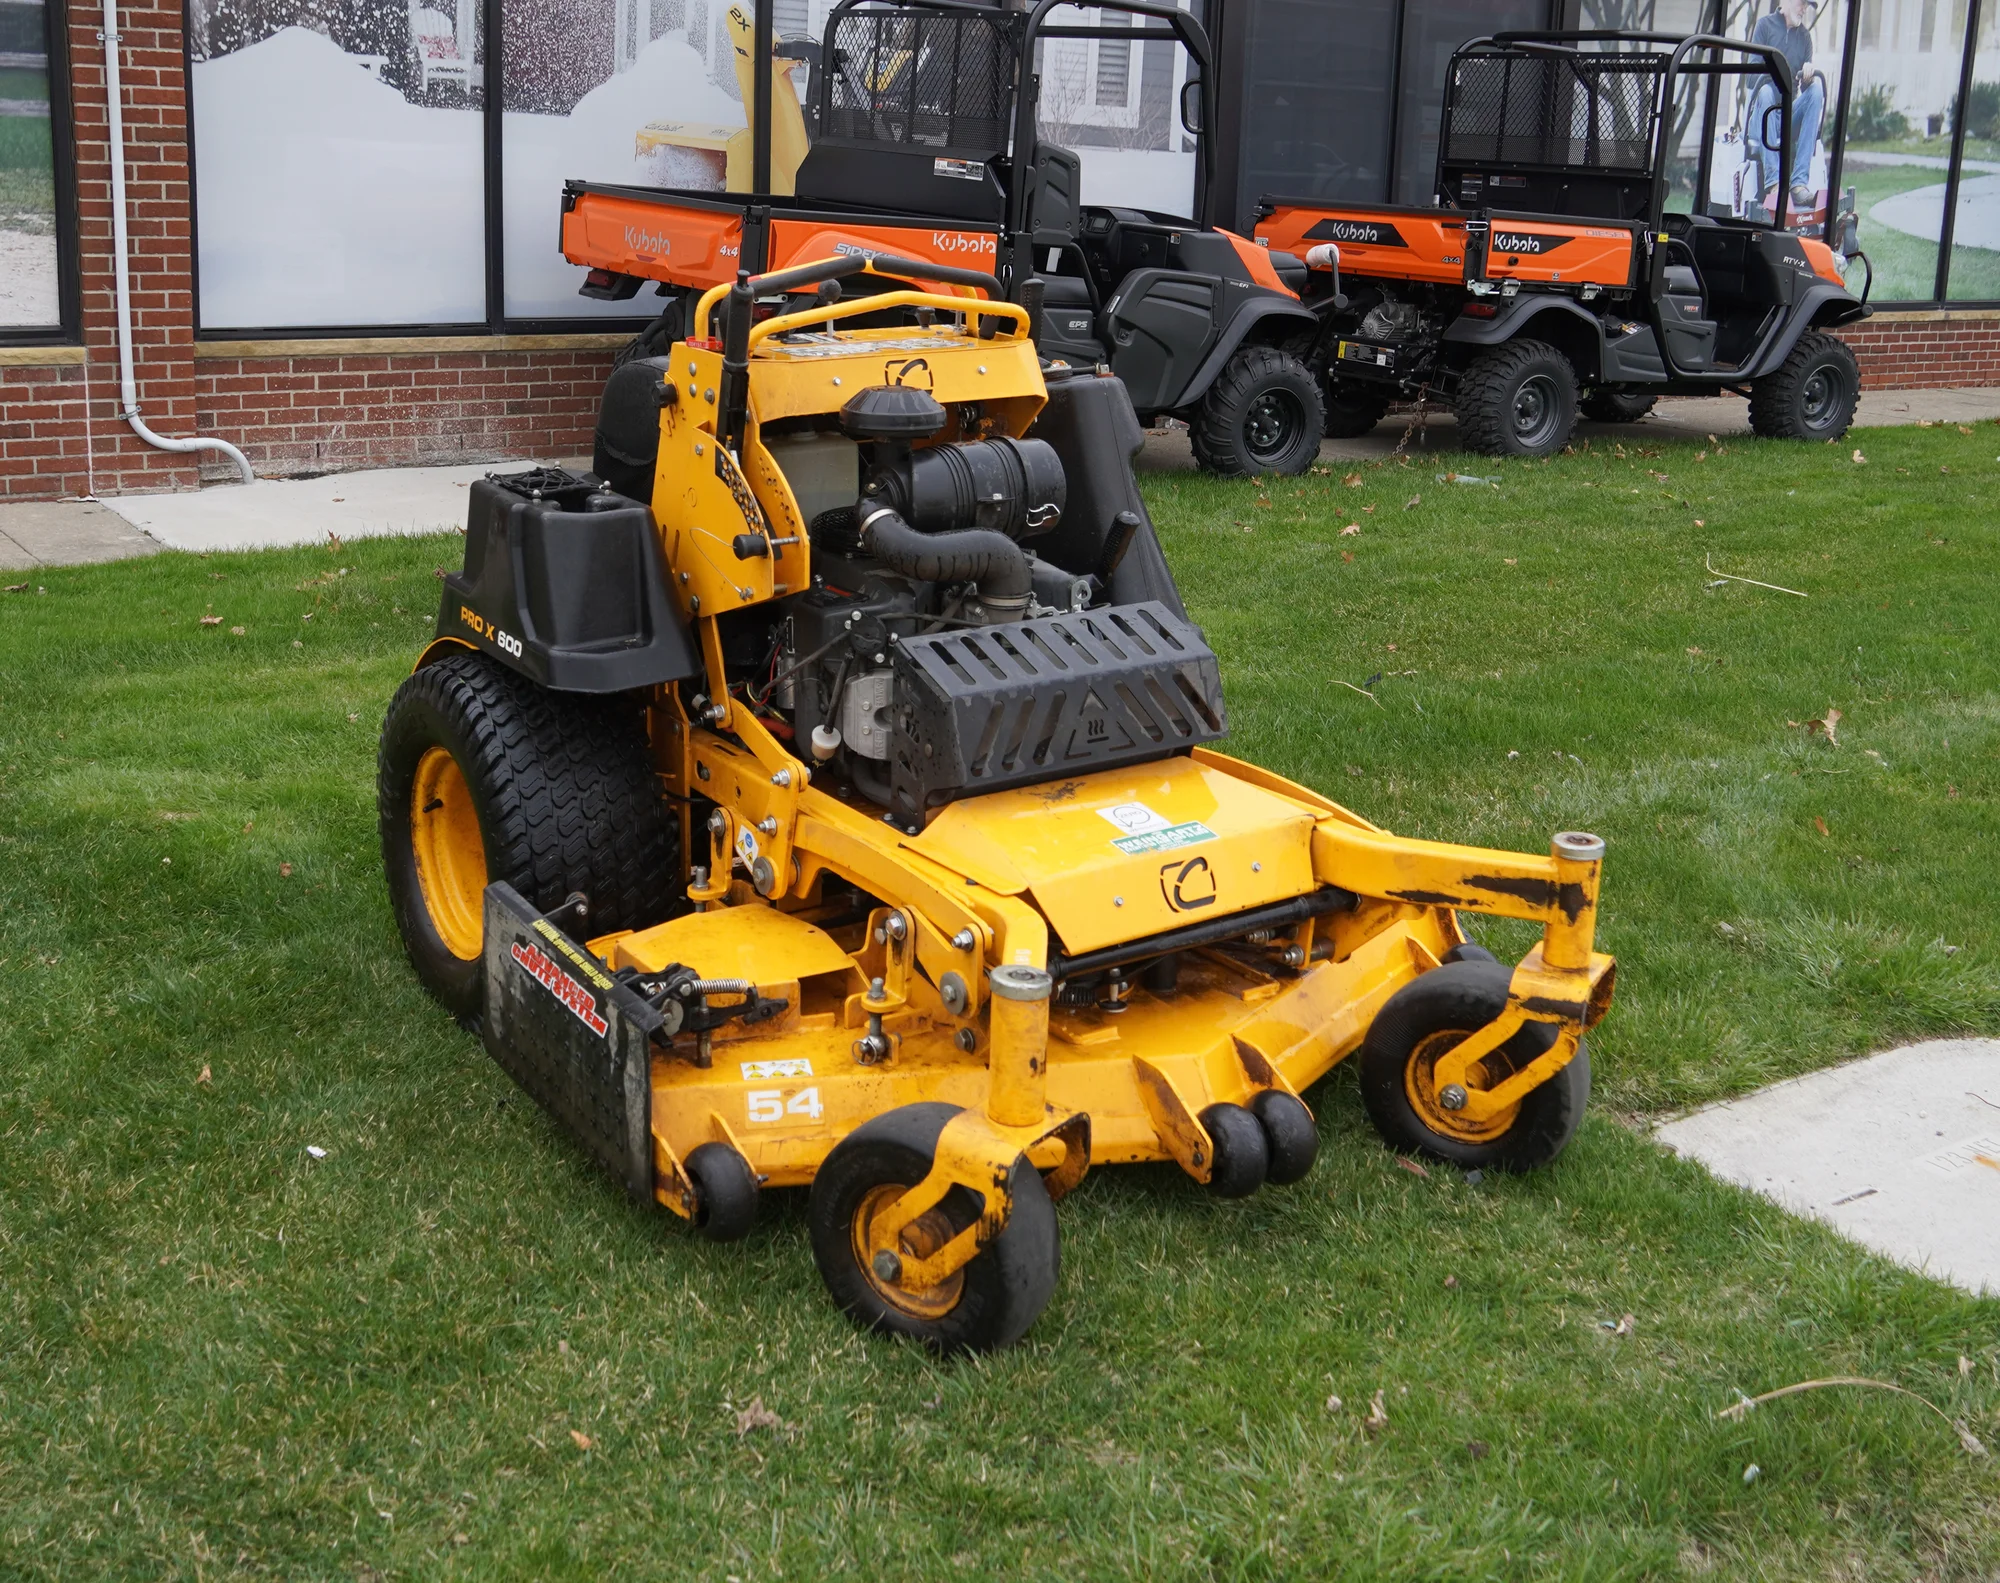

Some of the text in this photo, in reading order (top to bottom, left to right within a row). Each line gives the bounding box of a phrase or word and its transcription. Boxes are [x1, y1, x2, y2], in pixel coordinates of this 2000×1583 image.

[730, 7, 751, 32] 2X
[624, 226, 671, 255] Kubota
[1332, 222, 1378, 242] Kubota
[1494, 233, 1540, 252] Kubota
[720, 245, 739, 257] 4x4
[833, 242, 908, 260] SIDEK
[932, 232, 997, 254] Kubota
[1441, 256, 1461, 265] 4x4
[1069, 320, 1088, 328] EPS
[461, 605, 523, 658] PRO X 600
[569, 952, 586, 966] WITH
[526, 944, 596, 1010] ADVANCED
[511, 944, 607, 1035] CHUTE SYSTEM
[748, 1086, 824, 1123] 54
